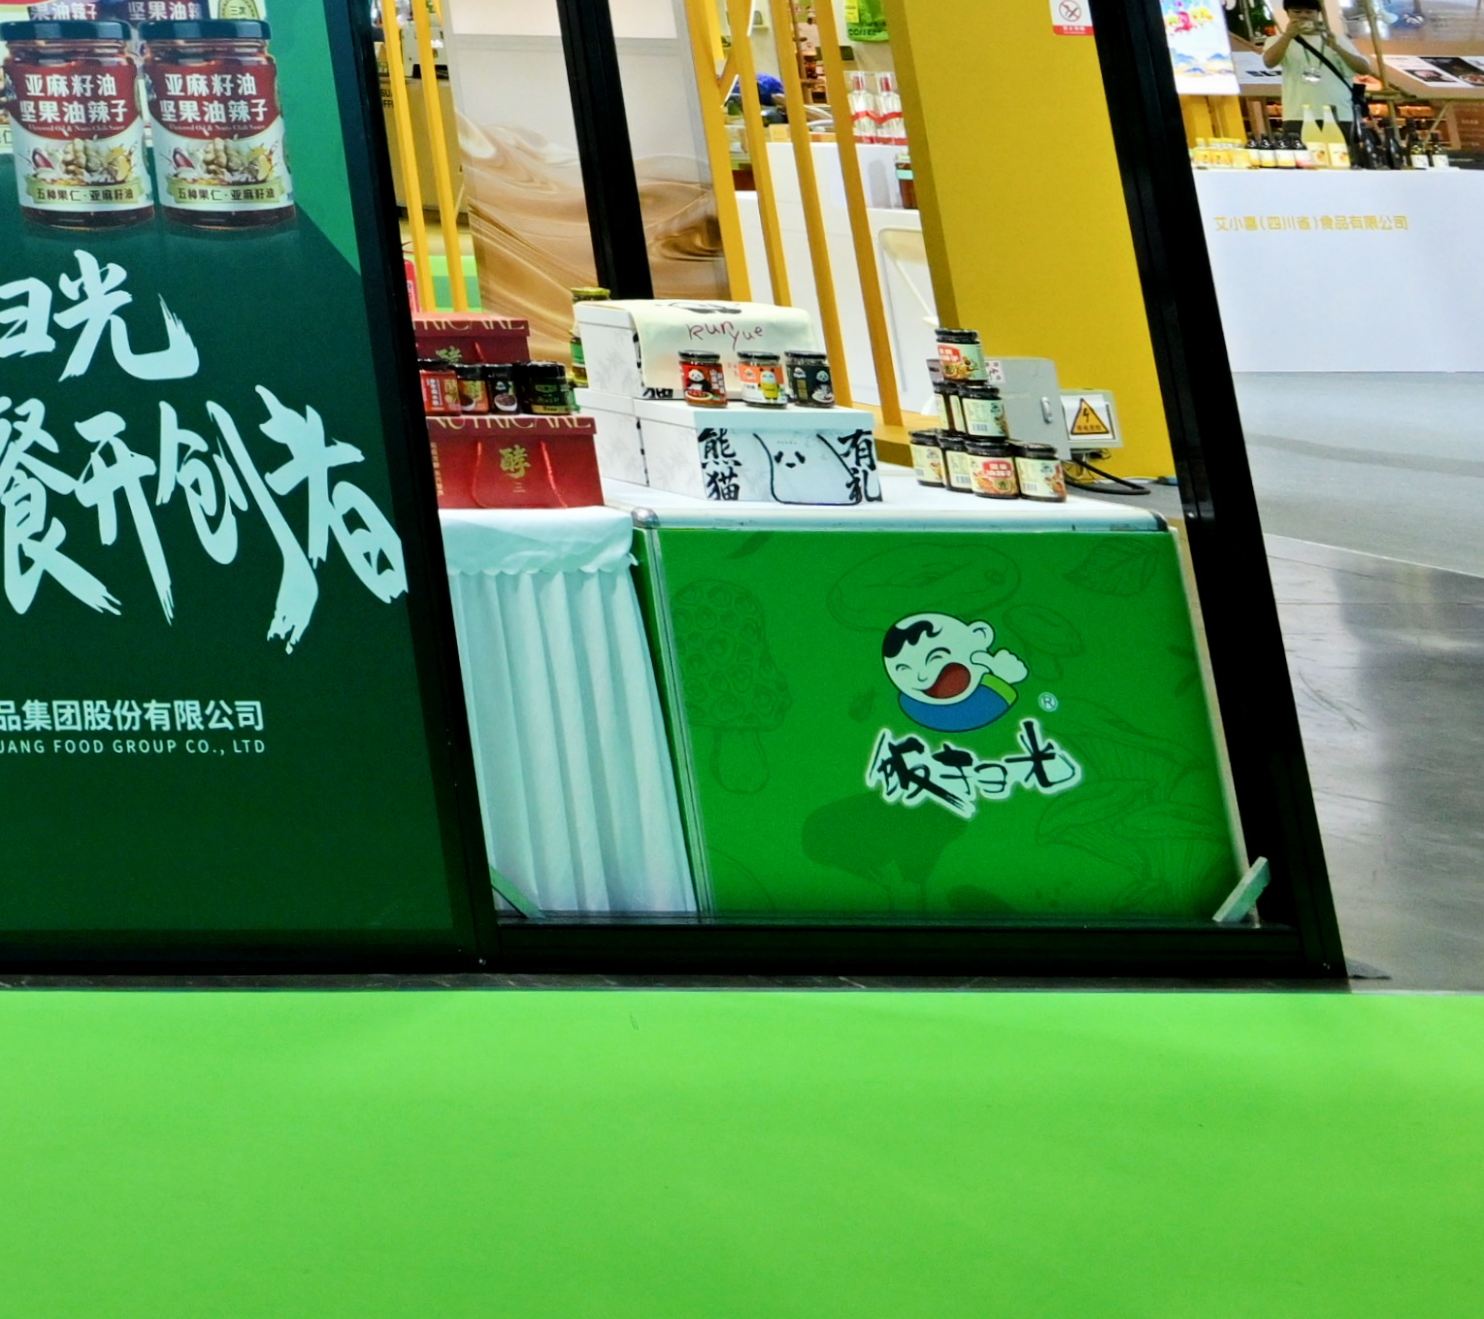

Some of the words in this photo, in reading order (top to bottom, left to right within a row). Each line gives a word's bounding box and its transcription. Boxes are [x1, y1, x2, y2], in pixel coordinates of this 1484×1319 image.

[25, 74, 117, 97] 亚麻籽油
[165, 74, 257, 97] 亚麻籽油
[19, 99, 128, 124] 坚果油辣子
[159, 99, 268, 124] 坚果油辣子
[698, 428, 742, 501] 熊猫
[53, 739, 104, 753] FOOD
[112, 739, 177, 753] GROUP
[232, 739, 265, 753] LTD
[868, 721, 1076, 815] 饭扫光
